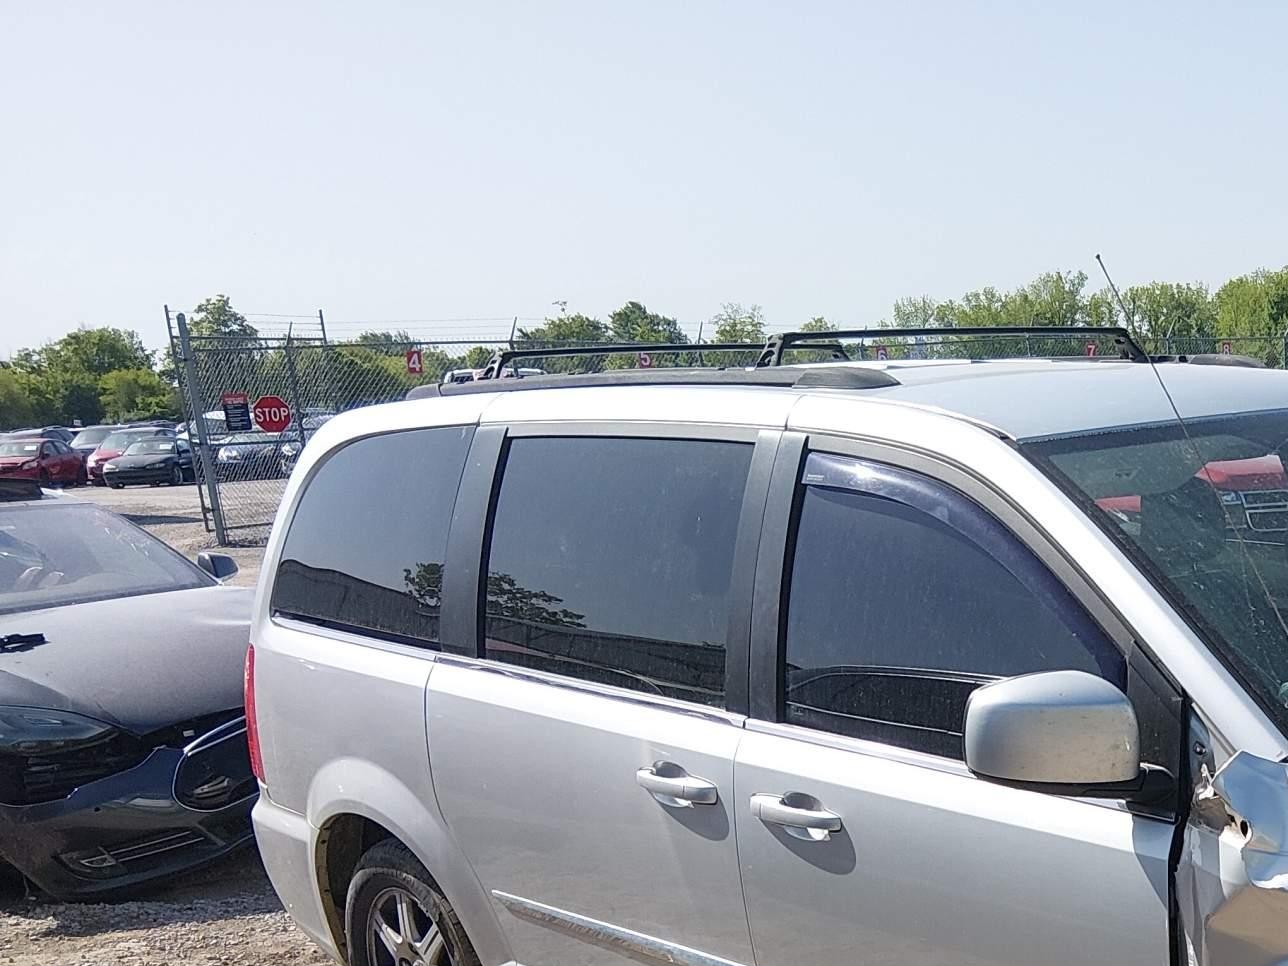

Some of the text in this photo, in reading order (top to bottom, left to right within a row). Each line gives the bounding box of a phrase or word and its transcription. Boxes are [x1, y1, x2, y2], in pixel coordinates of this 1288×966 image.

[1087, 344, 1096, 357] 7
[409, 353, 421, 371] 4
[640, 352, 651, 366] 5
[255, 407, 289, 423] STOP
